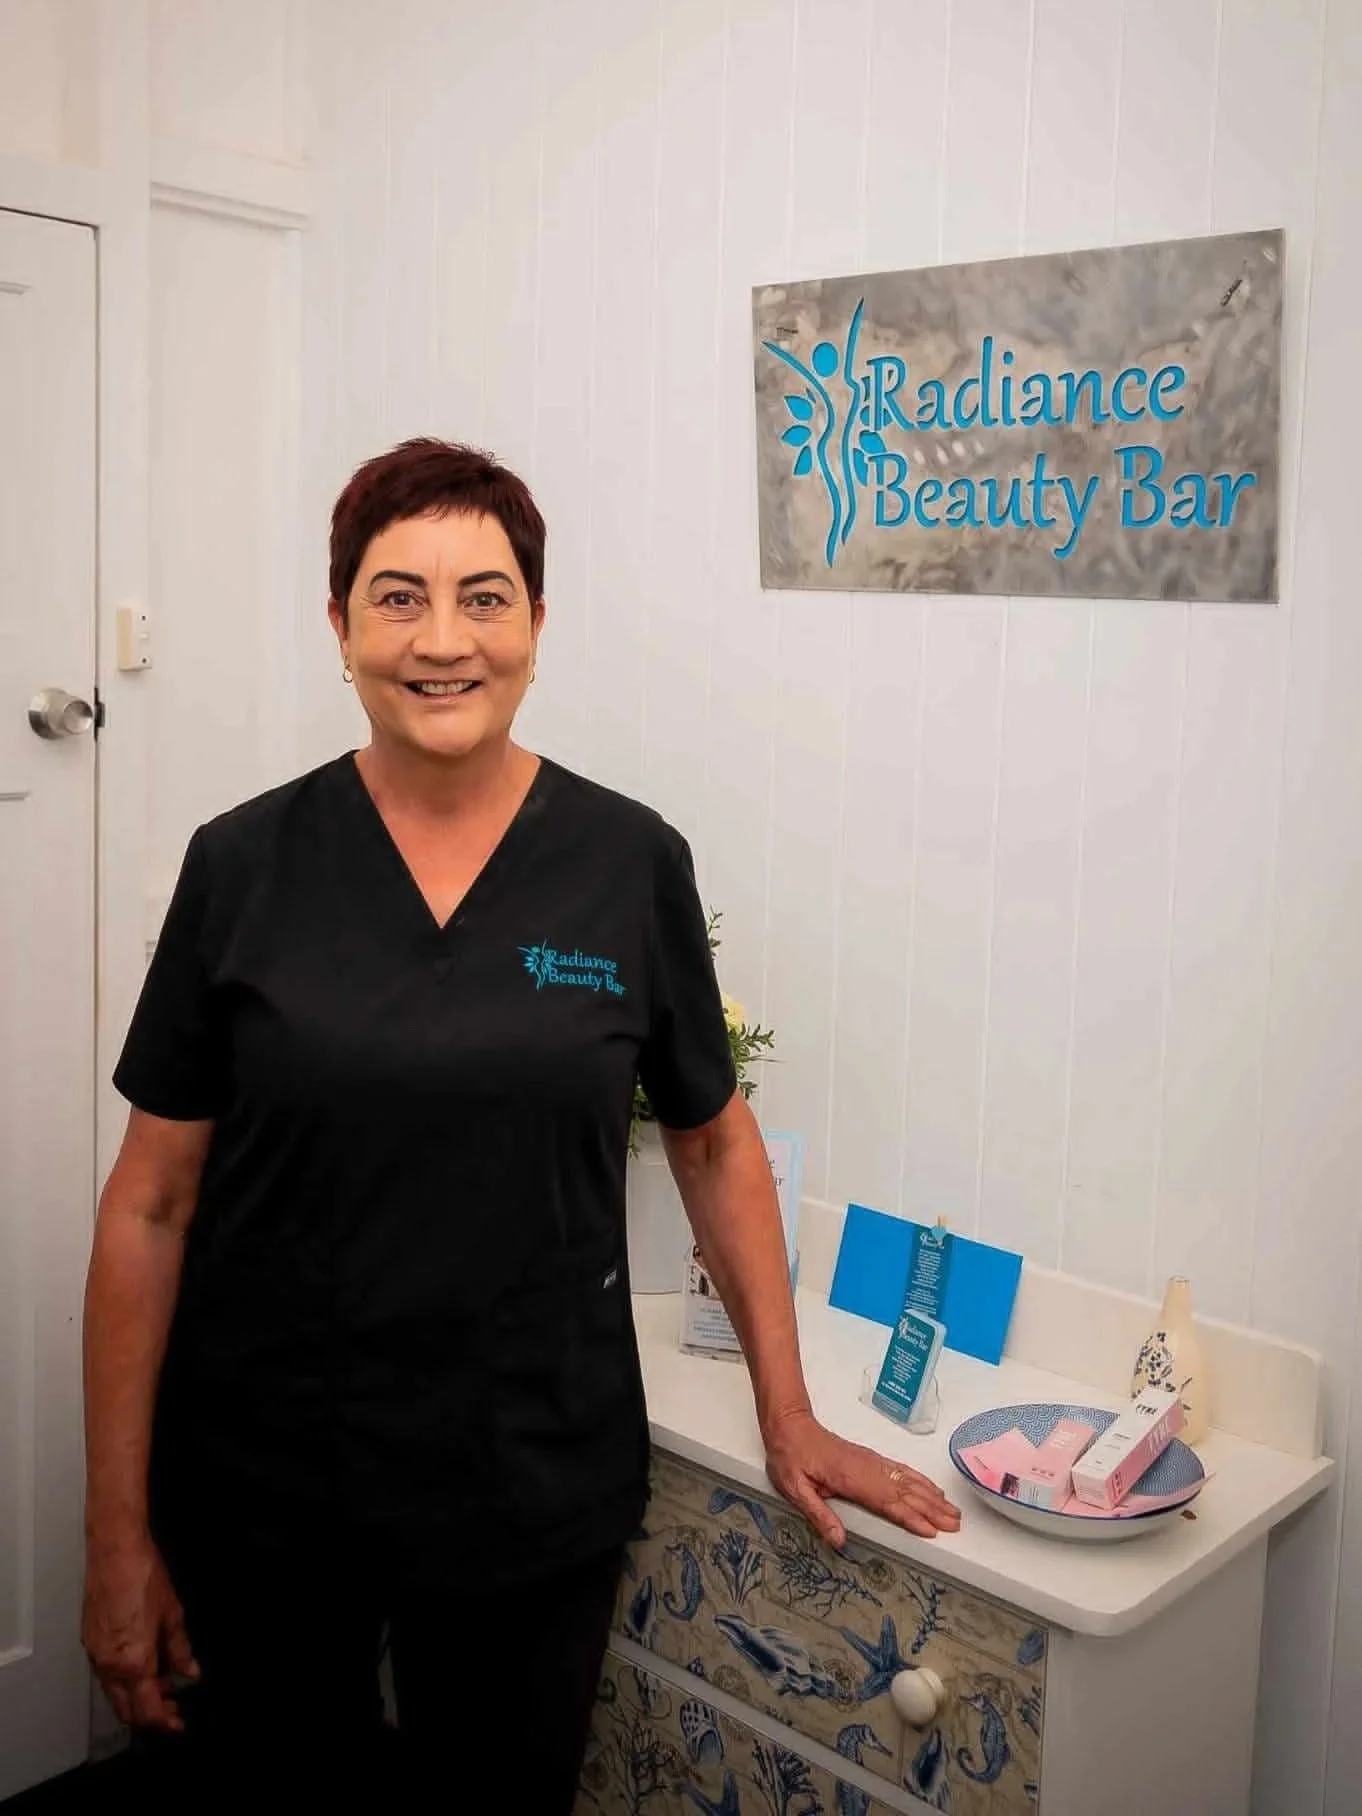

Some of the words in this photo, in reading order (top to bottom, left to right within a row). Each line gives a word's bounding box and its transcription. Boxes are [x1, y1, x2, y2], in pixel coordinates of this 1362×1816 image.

[866, 335, 1186, 432] Radiance
[868, 450, 1100, 560] Beauty
[1115, 445, 1257, 529] Bar
[545, 947, 617, 973] Radiance
[547, 967, 602, 992] Beauty
[605, 973, 626, 996] Bar
